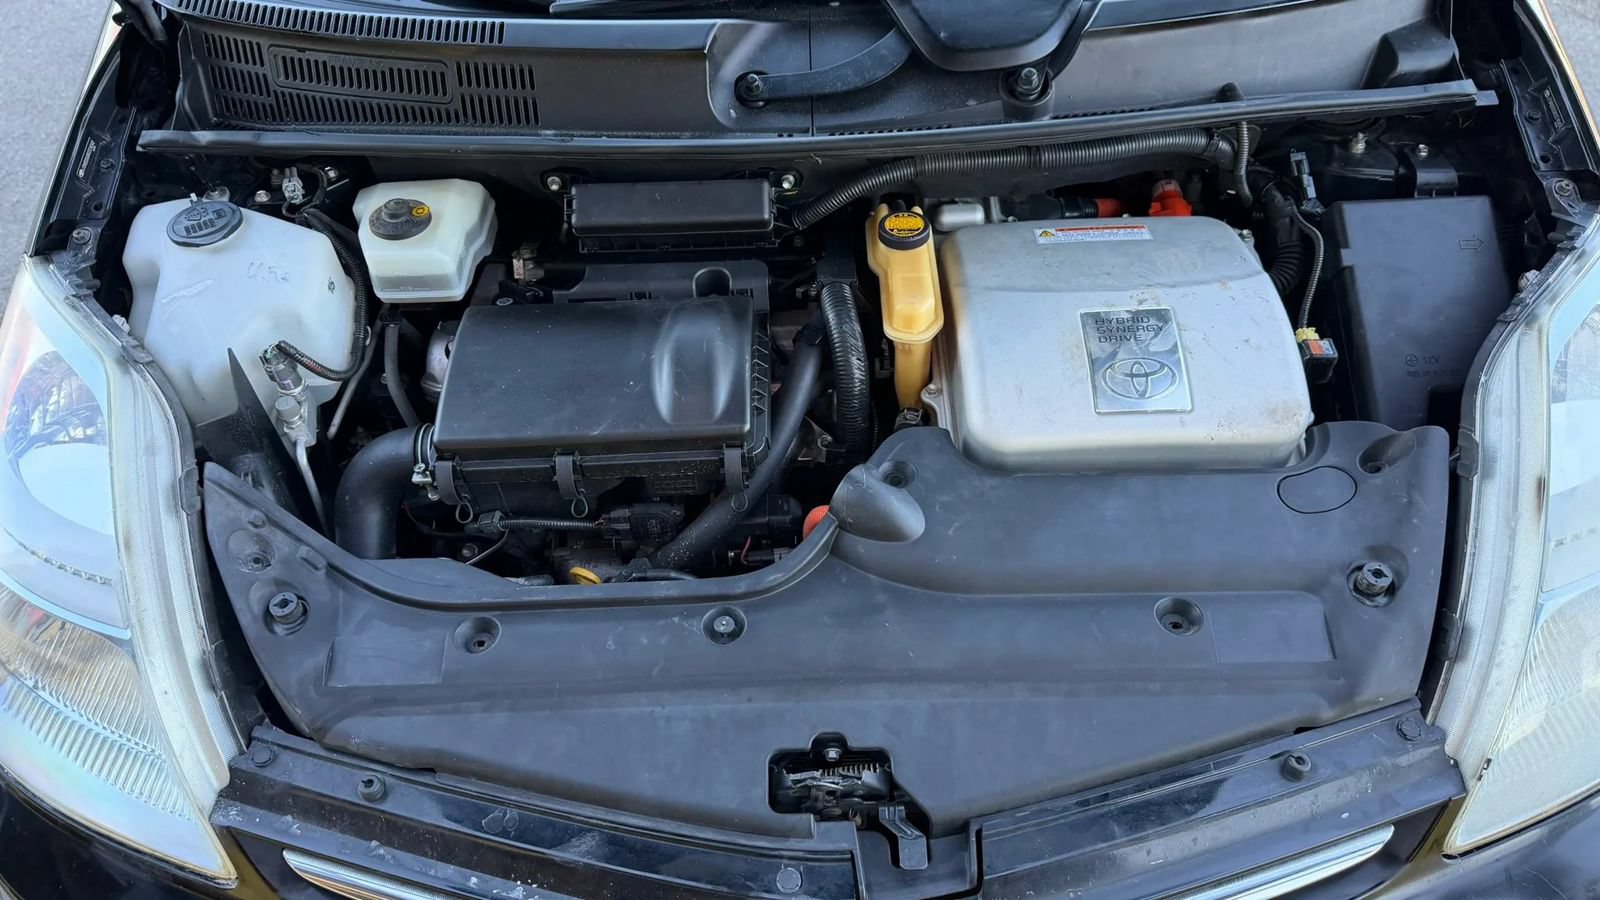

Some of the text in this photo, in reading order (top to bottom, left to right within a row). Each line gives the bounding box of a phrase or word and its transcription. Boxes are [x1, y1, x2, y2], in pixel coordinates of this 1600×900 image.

[1095, 316, 1150, 325] HYBRID
[1096, 325, 1163, 335] SYNERGY
[1098, 335, 1142, 343] DRIVE
